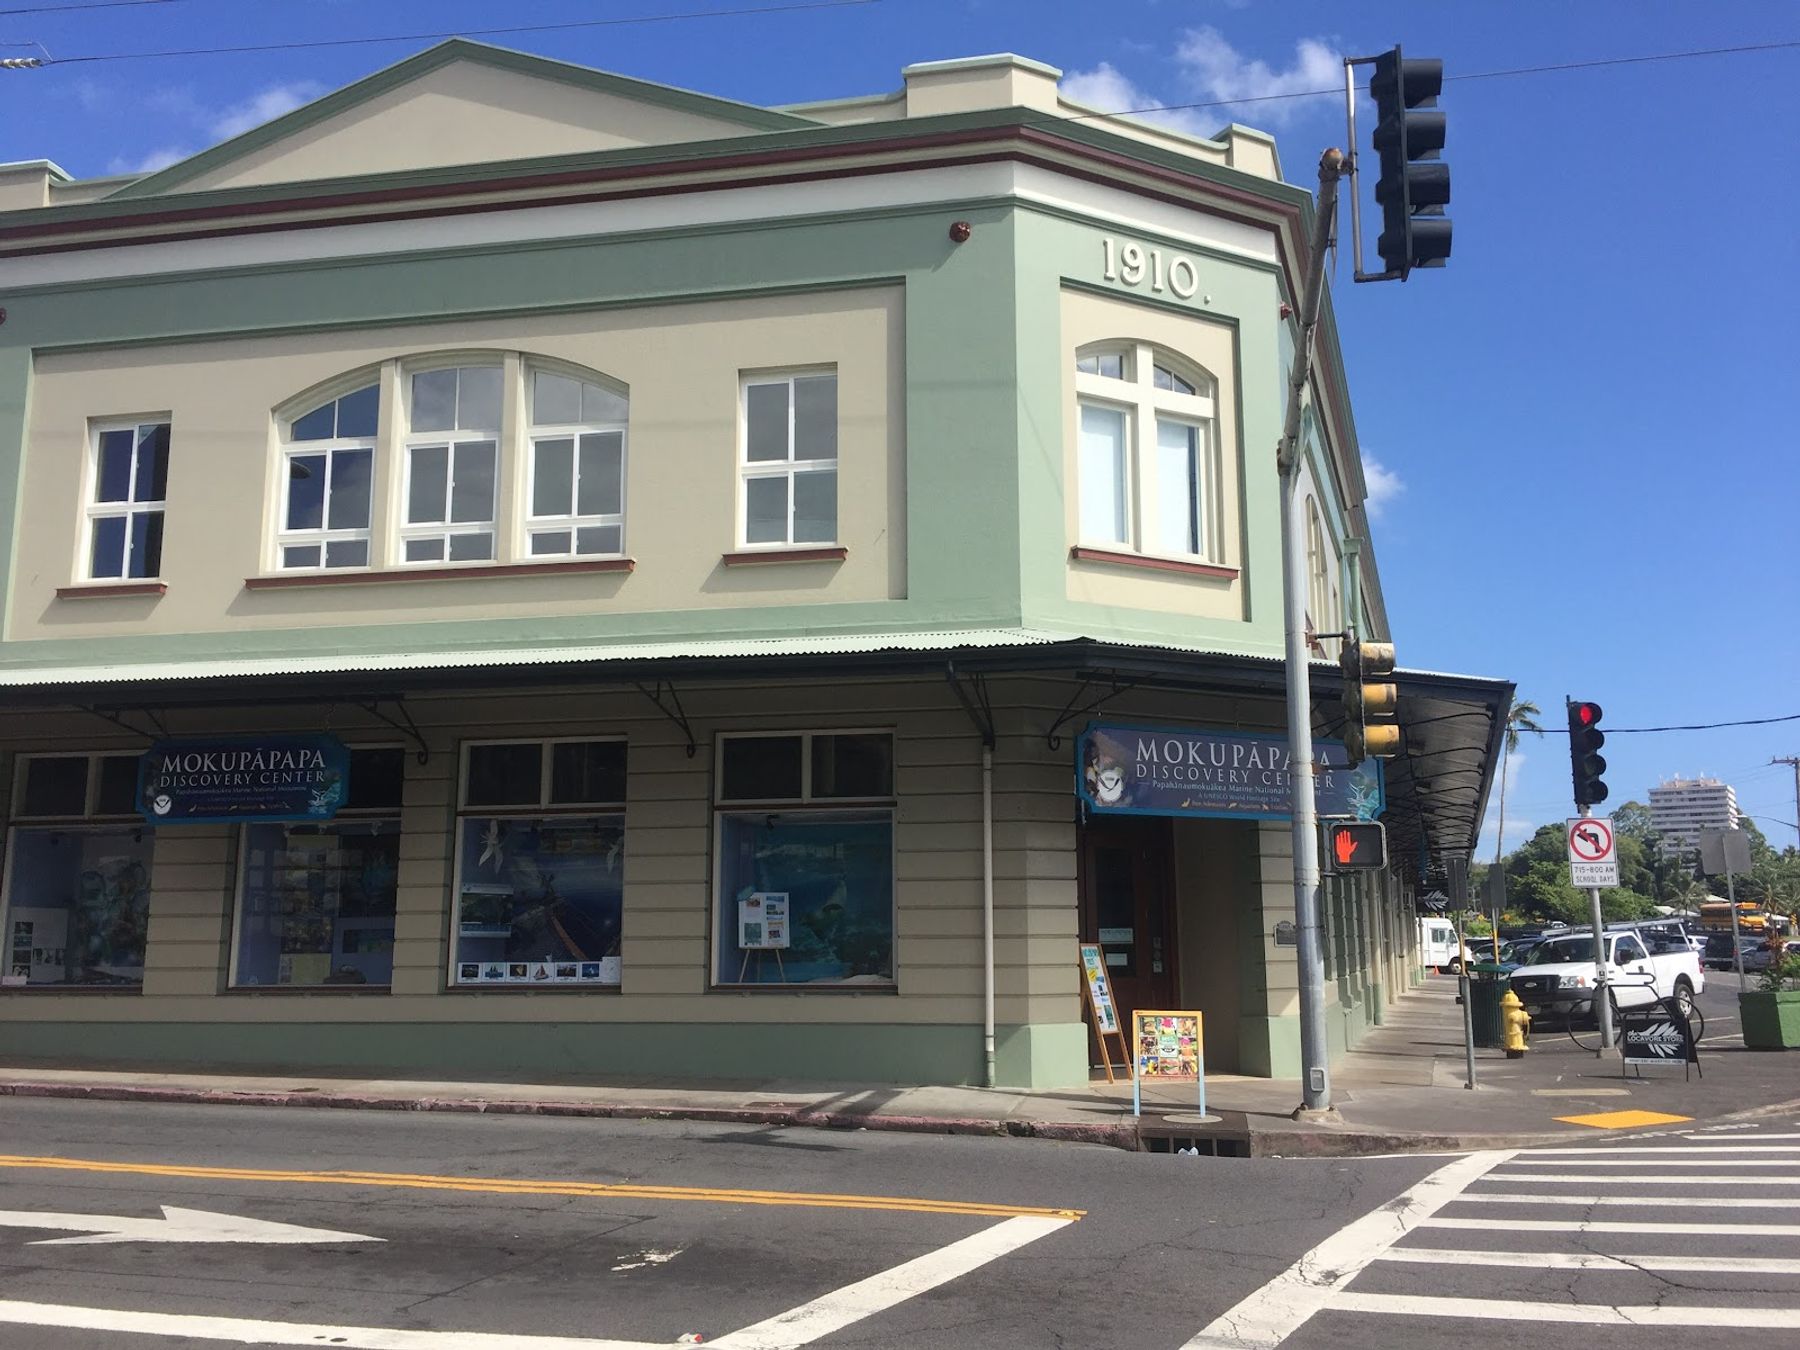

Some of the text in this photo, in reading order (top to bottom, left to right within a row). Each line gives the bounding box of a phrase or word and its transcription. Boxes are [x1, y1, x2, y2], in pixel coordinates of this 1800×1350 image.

[161, 748, 326, 773] MOKUPĀPAPA
[160, 771, 325, 788] DISCOVERY CENTER
[1136, 764, 1250, 784] DISCOVERY
[1229, 783, 1253, 792] Marine
[1255, 786, 1284, 795] National
